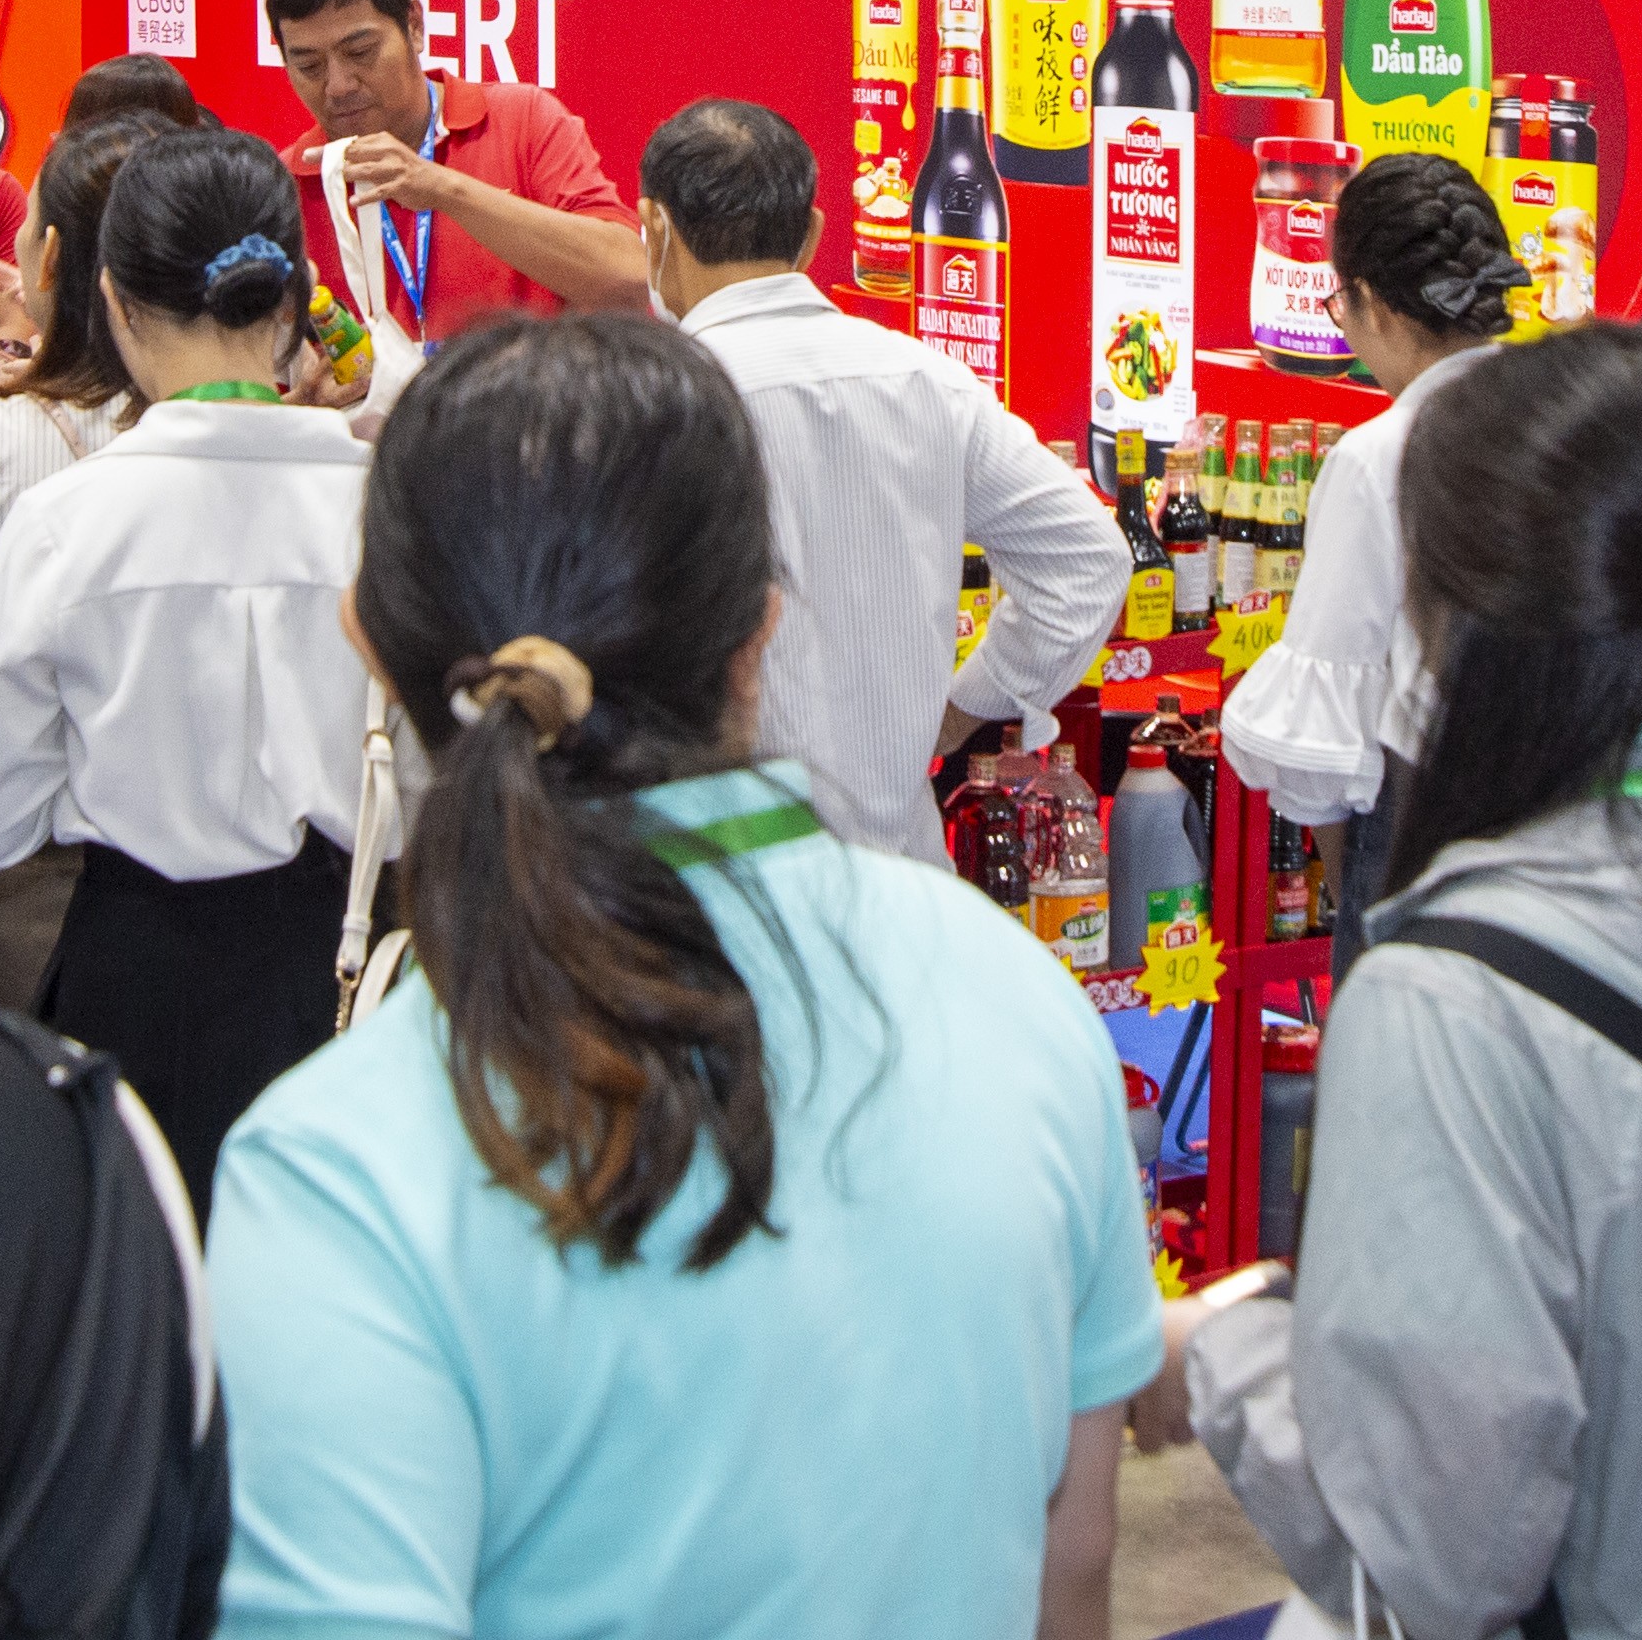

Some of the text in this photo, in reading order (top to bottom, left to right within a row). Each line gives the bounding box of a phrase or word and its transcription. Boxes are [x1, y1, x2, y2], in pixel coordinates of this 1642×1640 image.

[1393, 6, 1433, 29] haday
[137, 20, 185, 44] 粤贸全球
[1372, 38, 1463, 76] Dầu Hào
[885, 89, 899, 105] OIL
[1127, 131, 1160, 153] haday
[1372, 119, 1456, 150] THƯỢNG
[1114, 159, 1168, 188] NƯỚC
[1514, 184, 1554, 204] haday
[1290, 214, 1322, 235] haday
[919, 306, 1001, 341] HADAY SIGNATURE
[966, 342, 997, 370] SAUCE
[1233, 623, 1275, 649] 40K
